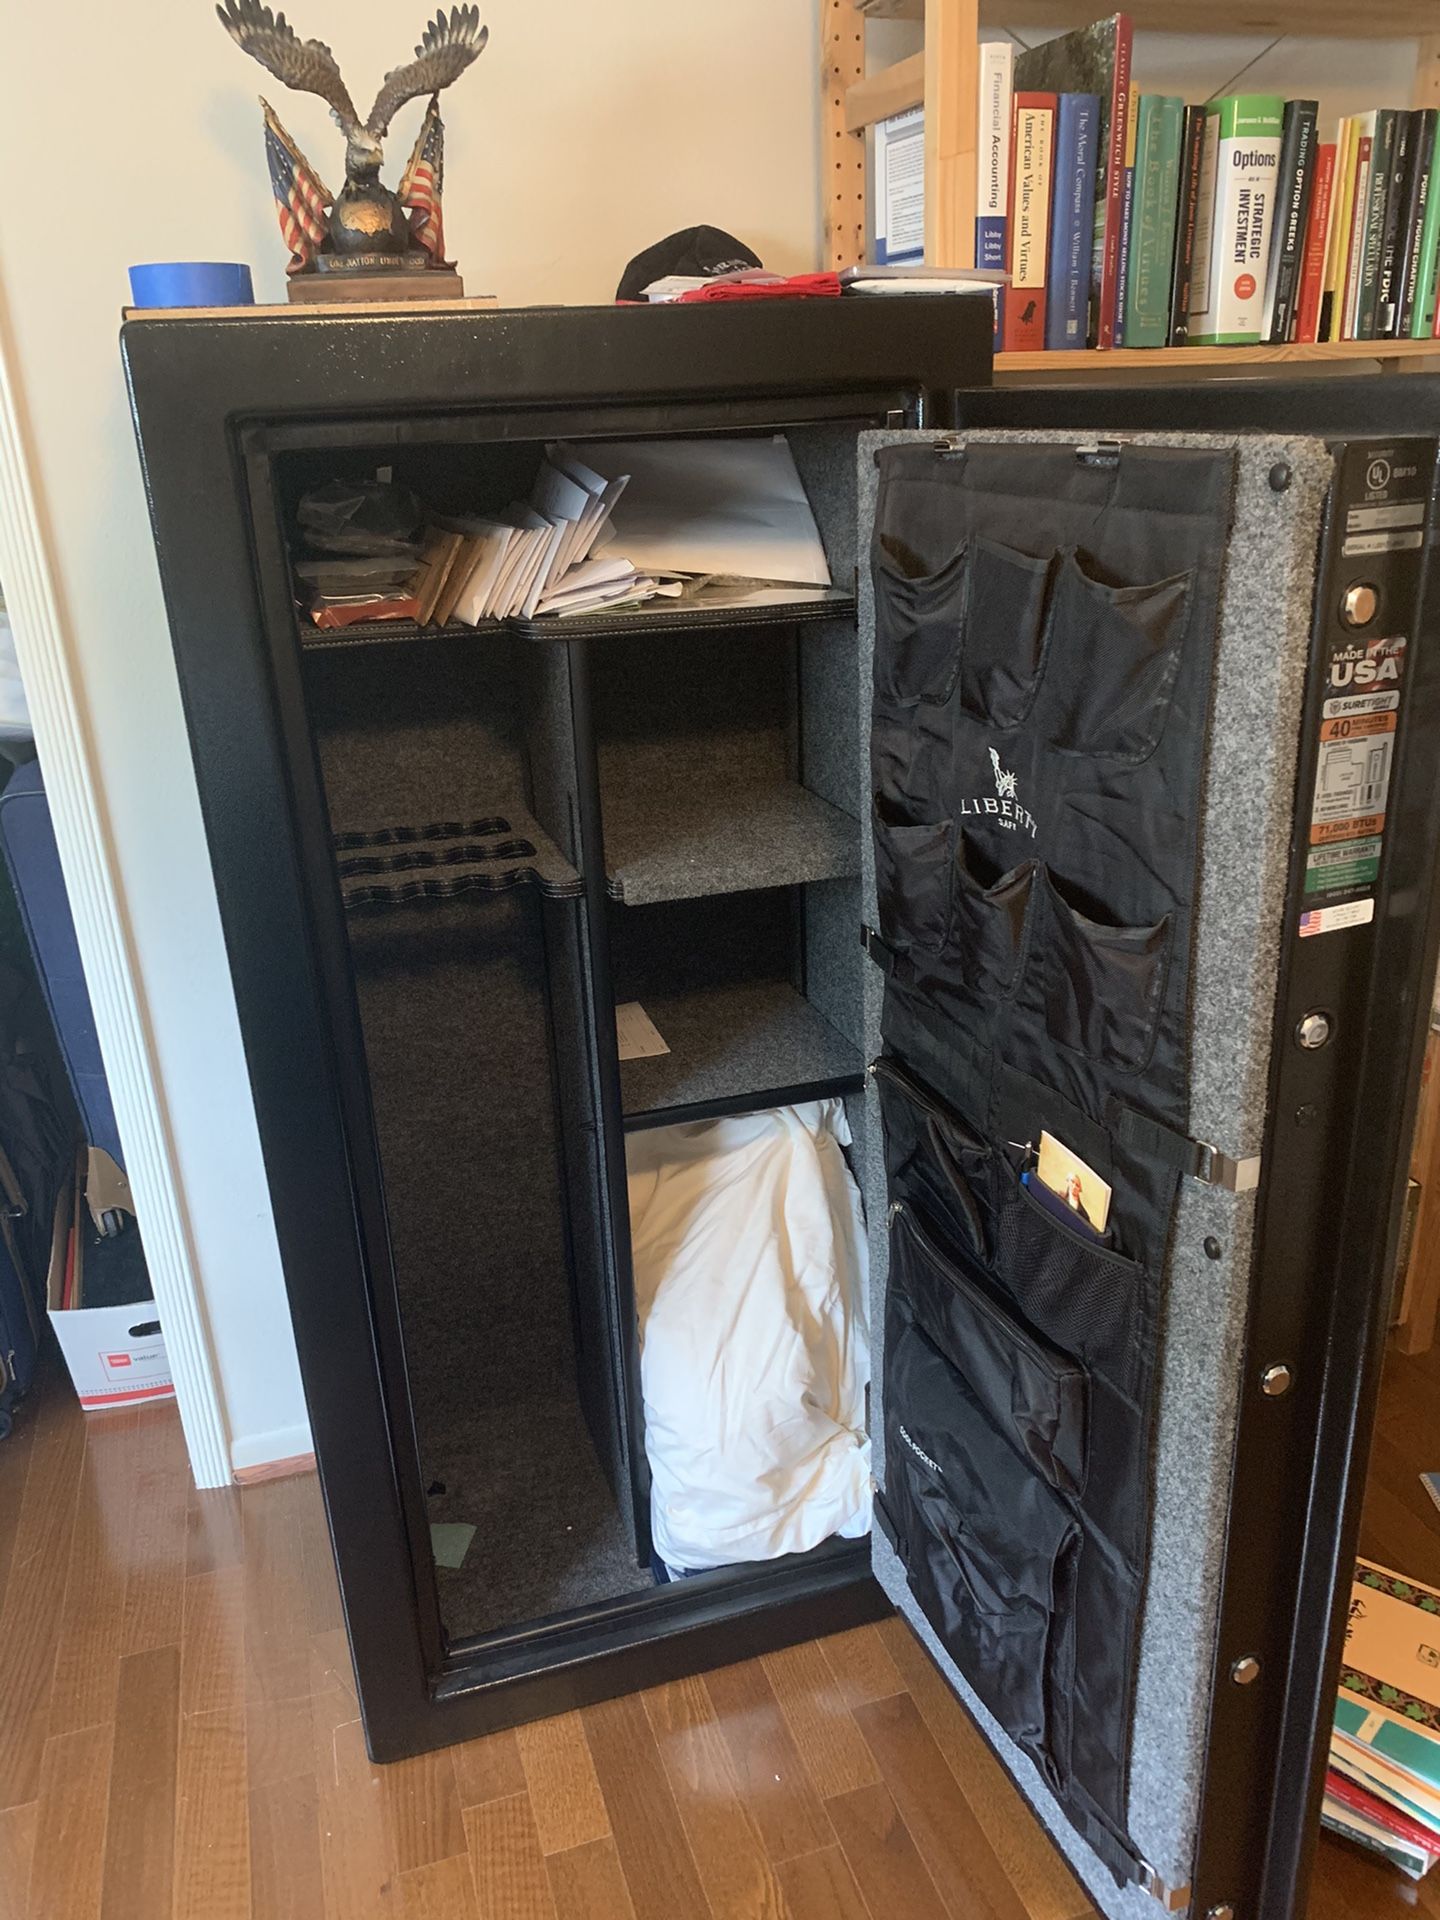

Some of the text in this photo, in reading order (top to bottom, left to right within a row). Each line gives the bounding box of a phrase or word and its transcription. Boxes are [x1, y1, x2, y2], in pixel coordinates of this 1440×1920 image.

[992, 72, 1003, 131] Financial
[1080, 111, 1088, 131] The
[1113, 92, 1126, 166] GREENWICH
[1077, 134, 1088, 165] Moral
[1232, 149, 1277, 171] Options
[1297, 121, 1311, 167] TRADING
[988, 134, 1002, 209] Accounting
[1111, 170, 1120, 198] STYLE
[1292, 168, 1304, 209] OPTION
[1420, 174, 1429, 205] POINT
[1019, 112, 1036, 282] American Values and Virtues
[1073, 168, 1086, 213] Compass
[1369, 172, 1385, 231] PROFESSIONAL
[984, 231, 1002, 239] Libby
[1234, 188, 1251, 265] INVESTMENT
[1250, 193, 1265, 259] STRATEGIC
[1286, 211, 1299, 252] GREEKS
[1412, 219, 1424, 253] FIGURE
[984, 242, 1002, 251] Libby
[1072, 231, 1081, 267] William
[1384, 245, 1395, 267] THE
[1380, 270, 1392, 303] FDIC
[1407, 254, 1419, 303] CHARTING
[1332, 646, 1400, 662] MADE IN THE
[1330, 657, 1399, 688] USA
[1329, 719, 1352, 738] 40
[960, 797, 1038, 839] LIBERTY
